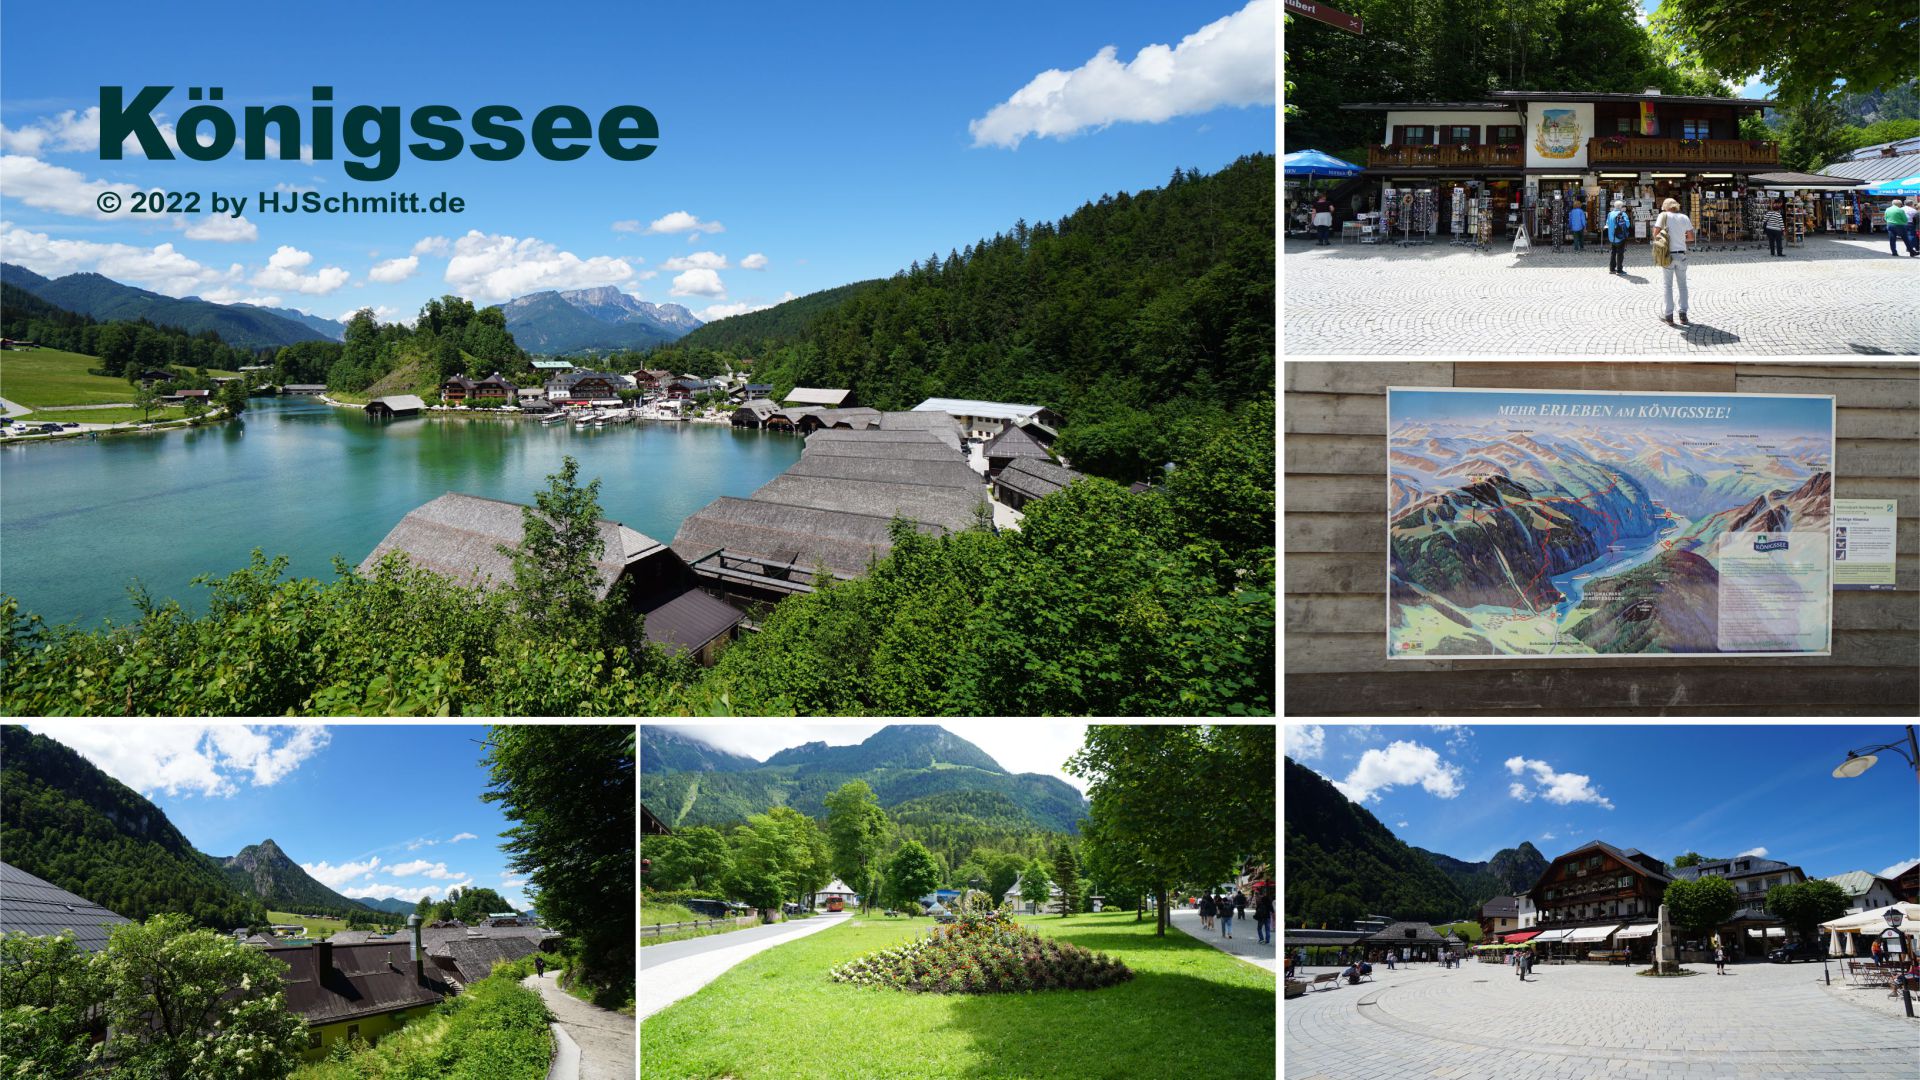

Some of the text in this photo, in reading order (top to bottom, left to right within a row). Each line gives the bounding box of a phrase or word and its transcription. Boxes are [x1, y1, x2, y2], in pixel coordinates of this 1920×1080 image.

[1497, 403, 1732, 419] MEHR ERLEBEN AM KÖNIGSSEE!
